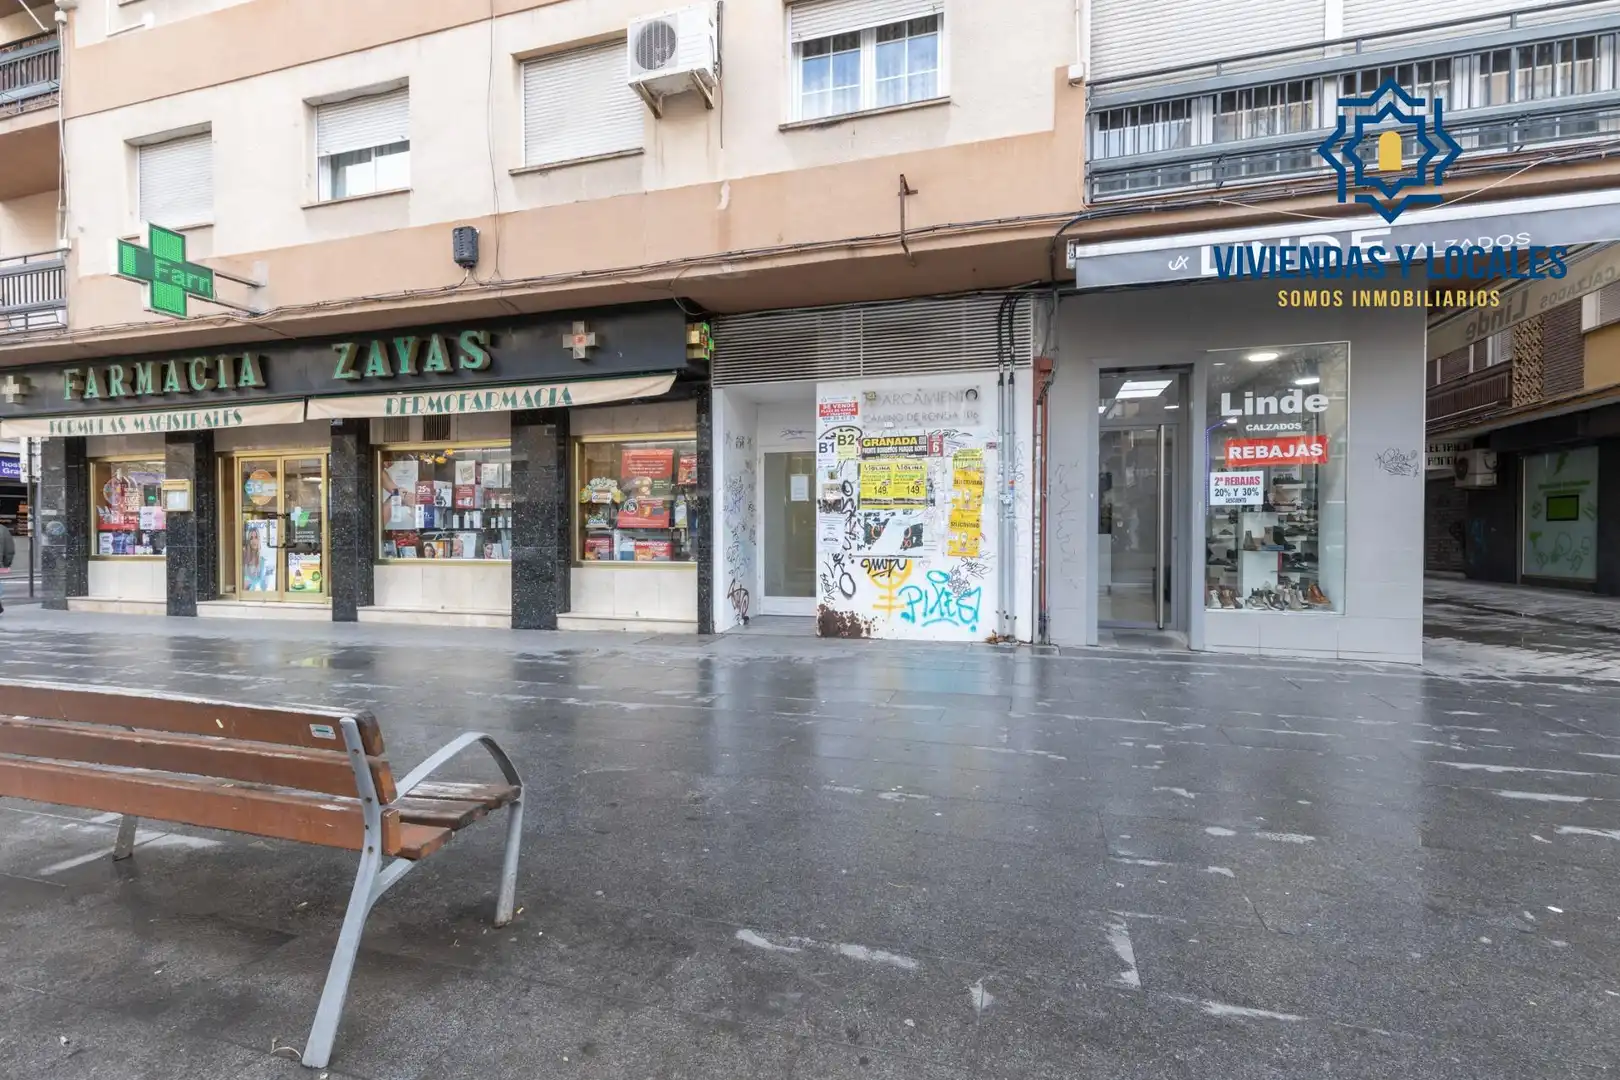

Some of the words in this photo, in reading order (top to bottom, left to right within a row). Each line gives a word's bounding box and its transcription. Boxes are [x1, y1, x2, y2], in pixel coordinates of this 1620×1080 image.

[63, 352, 262, 400] FARMACIA
[332, 330, 491, 380] ZAYAS
[385, 386, 573, 415] DERMOFARMACIA
[862, 388, 978, 406] ARCAMIENTO
[1221, 389, 1329, 416] Linde
[133, 408, 243, 432] MAGISTRALES
[906, 410, 920, 422] DE
[922, 410, 958, 421] RONDA
[1245, 423, 1302, 432] CALZADOS
[837, 434, 855, 446] B2
[862, 436, 918, 447] GRANADA
[819, 442, 835, 454] B1
[1228, 443, 1324, 460] REBAJAS
[1225, 476, 1261, 486] REBAJAS
[1214, 488, 1231, 497] 20%
[1233, 488, 1239, 497] Y
[1242, 487, 1260, 497] 30%
